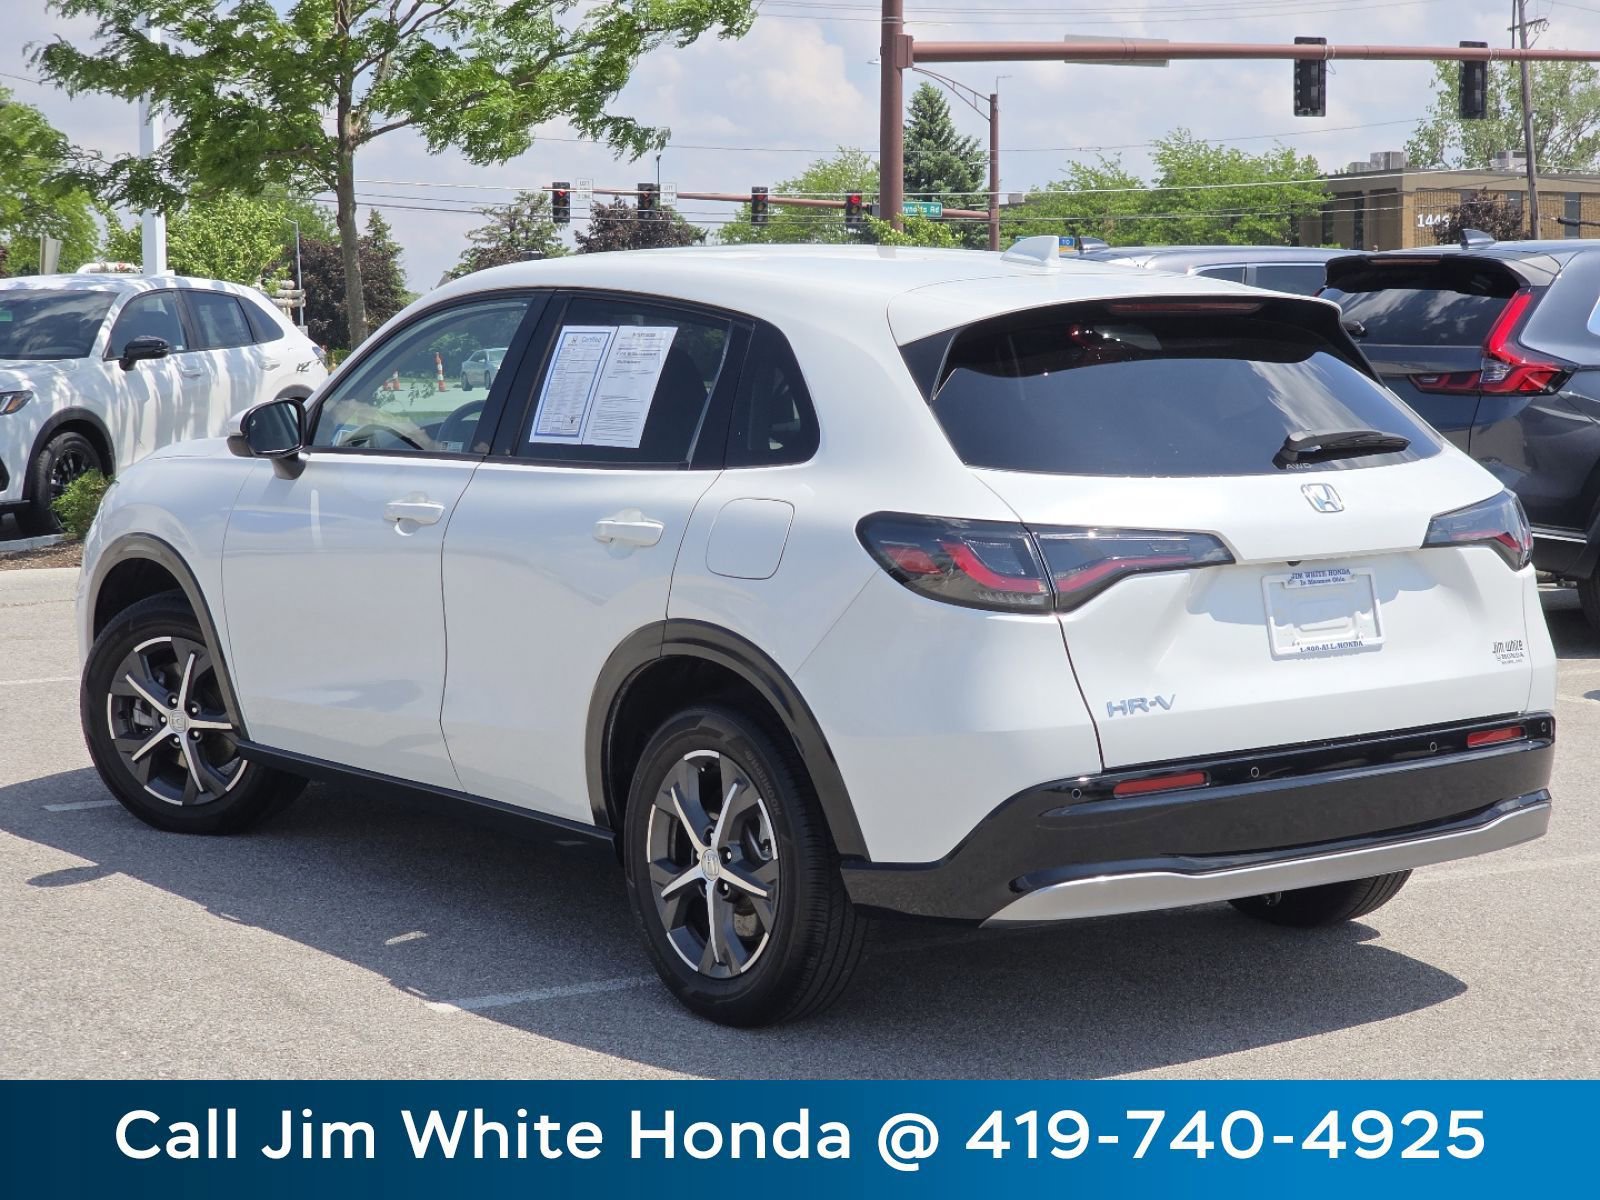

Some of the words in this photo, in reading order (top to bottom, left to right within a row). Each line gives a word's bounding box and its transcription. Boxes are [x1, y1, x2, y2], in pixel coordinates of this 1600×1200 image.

[929, 205, 941, 214] Rd
[1285, 462, 1312, 470] AWD
[1291, 572, 1303, 580] JIM
[1304, 570, 1327, 579] WHITE
[1328, 568, 1351, 577] HONDA
[1106, 693, 1176, 718] HR-V
